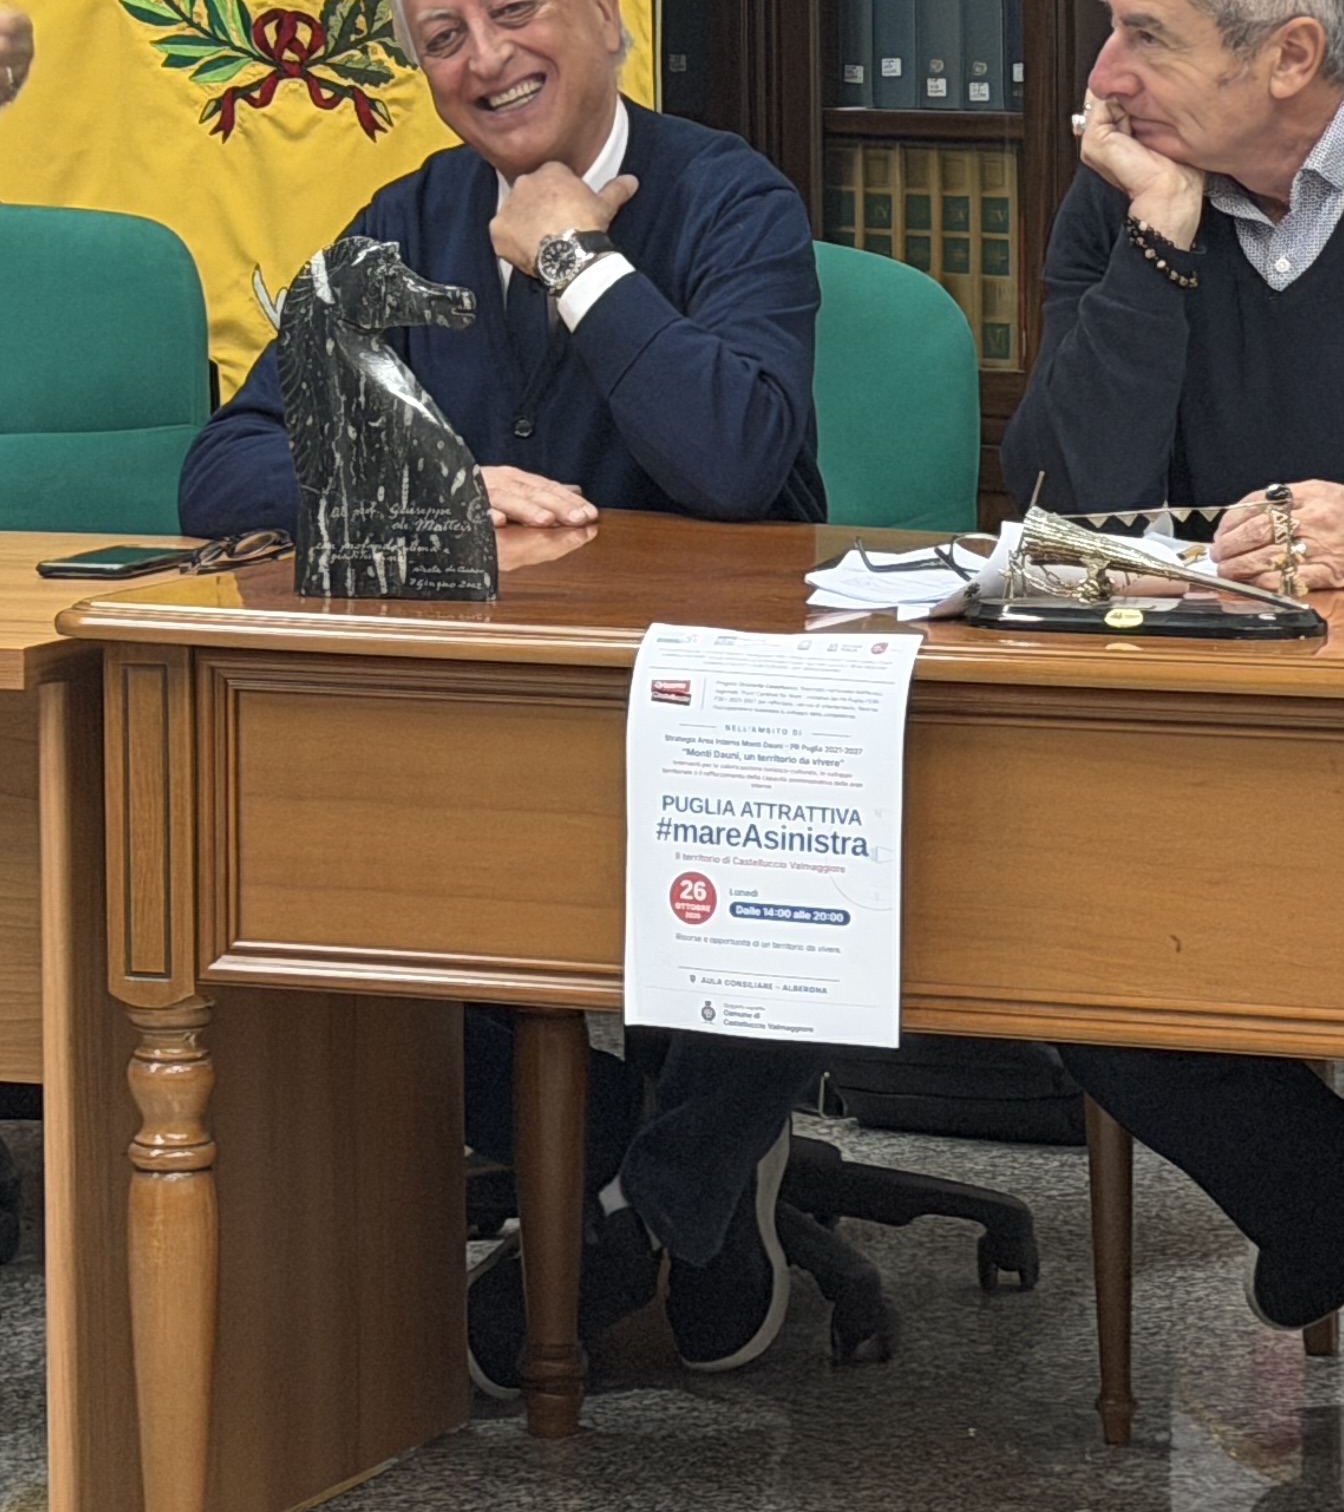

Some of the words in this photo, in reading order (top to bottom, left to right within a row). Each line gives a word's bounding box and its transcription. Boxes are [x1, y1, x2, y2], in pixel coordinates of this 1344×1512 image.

[744, 753, 755, 761] un
[757, 753, 797, 764] territorio
[799, 756, 810, 765] da
[661, 794, 735, 817] PUGLIA
[740, 801, 863, 826] ATTRATTIVA
[655, 816, 870, 857] #mareAsinistra
[682, 853, 720, 864] territorio
[722, 856, 731, 864] di
[732, 856, 787, 868] Castelluccio
[789, 861, 846, 874] Valmaggiore
[679, 879, 707, 901] 26
[735, 905, 761, 916] Dalle
[762, 907, 791, 918] 14:00
[793, 909, 811, 920] alle
[812, 911, 844, 922] 20:00
[700, 977, 722, 985] AULA
[782, 985, 828, 994] ALBERONA
